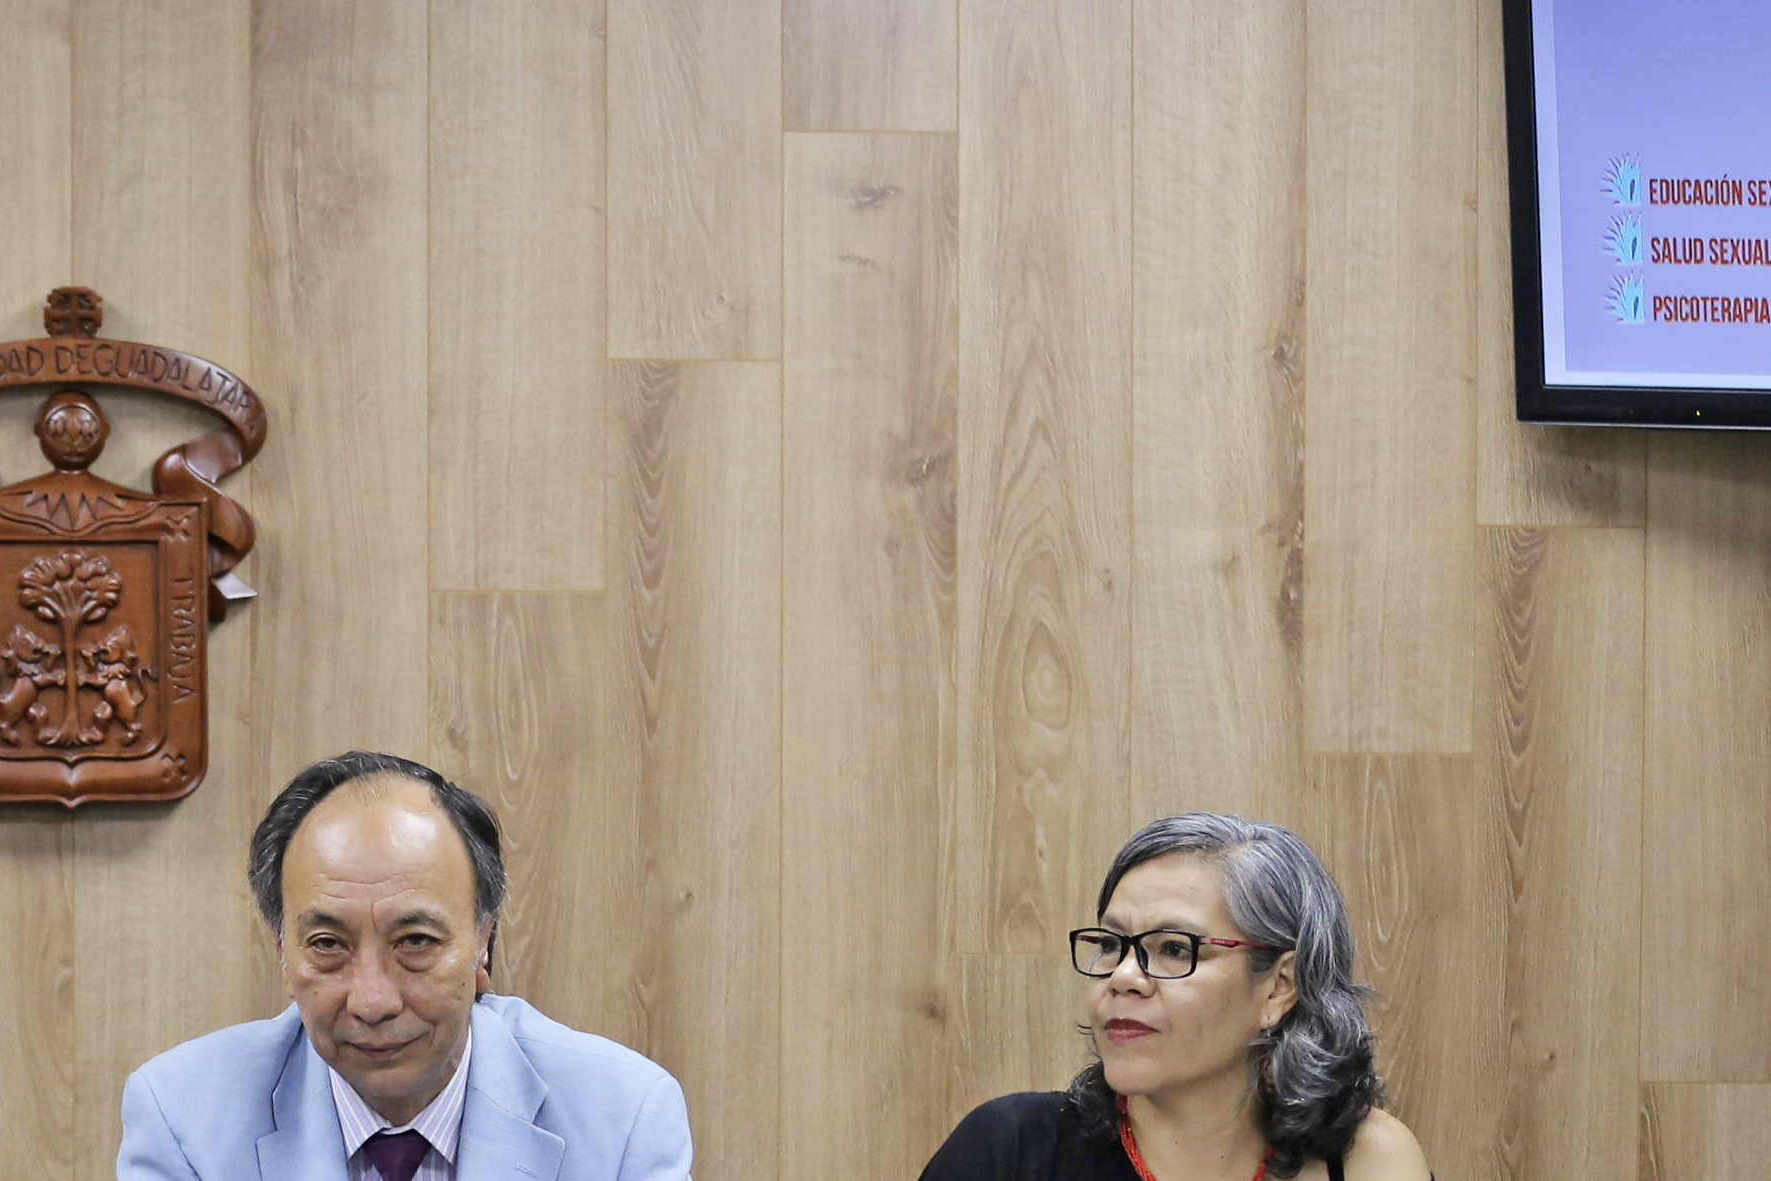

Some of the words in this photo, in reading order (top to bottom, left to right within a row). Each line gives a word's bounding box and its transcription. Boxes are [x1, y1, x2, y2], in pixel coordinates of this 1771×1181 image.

[1649, 174, 1742, 205] EDUCACIÓN
[1748, 180, 1771, 206] SE
[1651, 238, 1704, 264] SALUD
[1709, 238, 1771, 266] SEXUAL
[1653, 296, 1770, 323] PSICOTERAPIA
[55, 344, 91, 374] DE
[167, 576, 196, 703] TRABAJA
